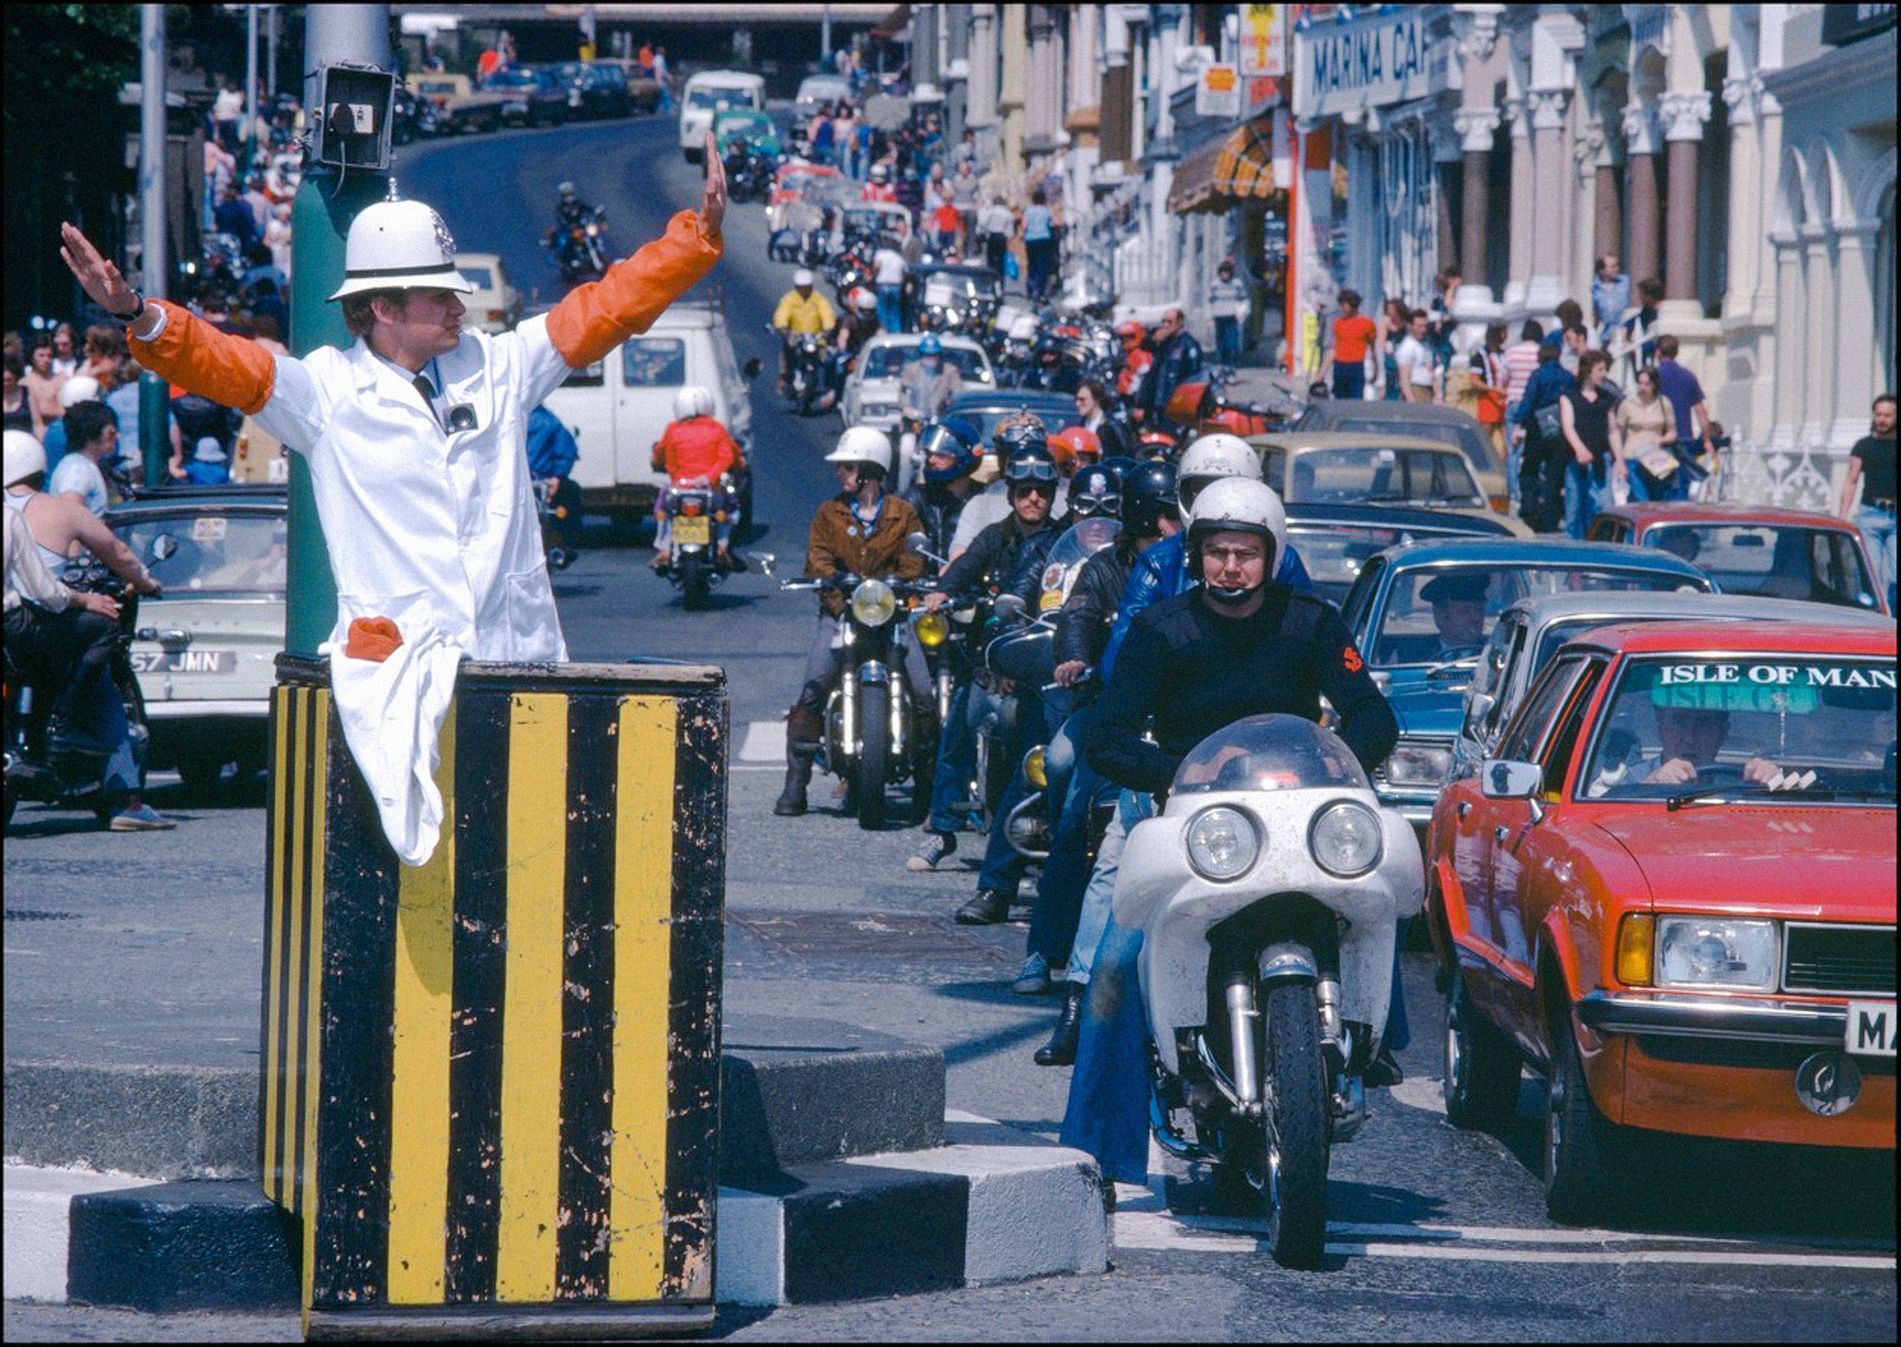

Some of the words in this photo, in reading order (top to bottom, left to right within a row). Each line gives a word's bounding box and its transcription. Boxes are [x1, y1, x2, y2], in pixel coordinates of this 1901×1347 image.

[1312, 30, 1382, 95] MARINA
[169, 651, 219, 672] JMN
[1660, 664, 1740, 685] ISLE
[1748, 665, 1798, 685] OF
[1805, 667, 1897, 688] MAN
